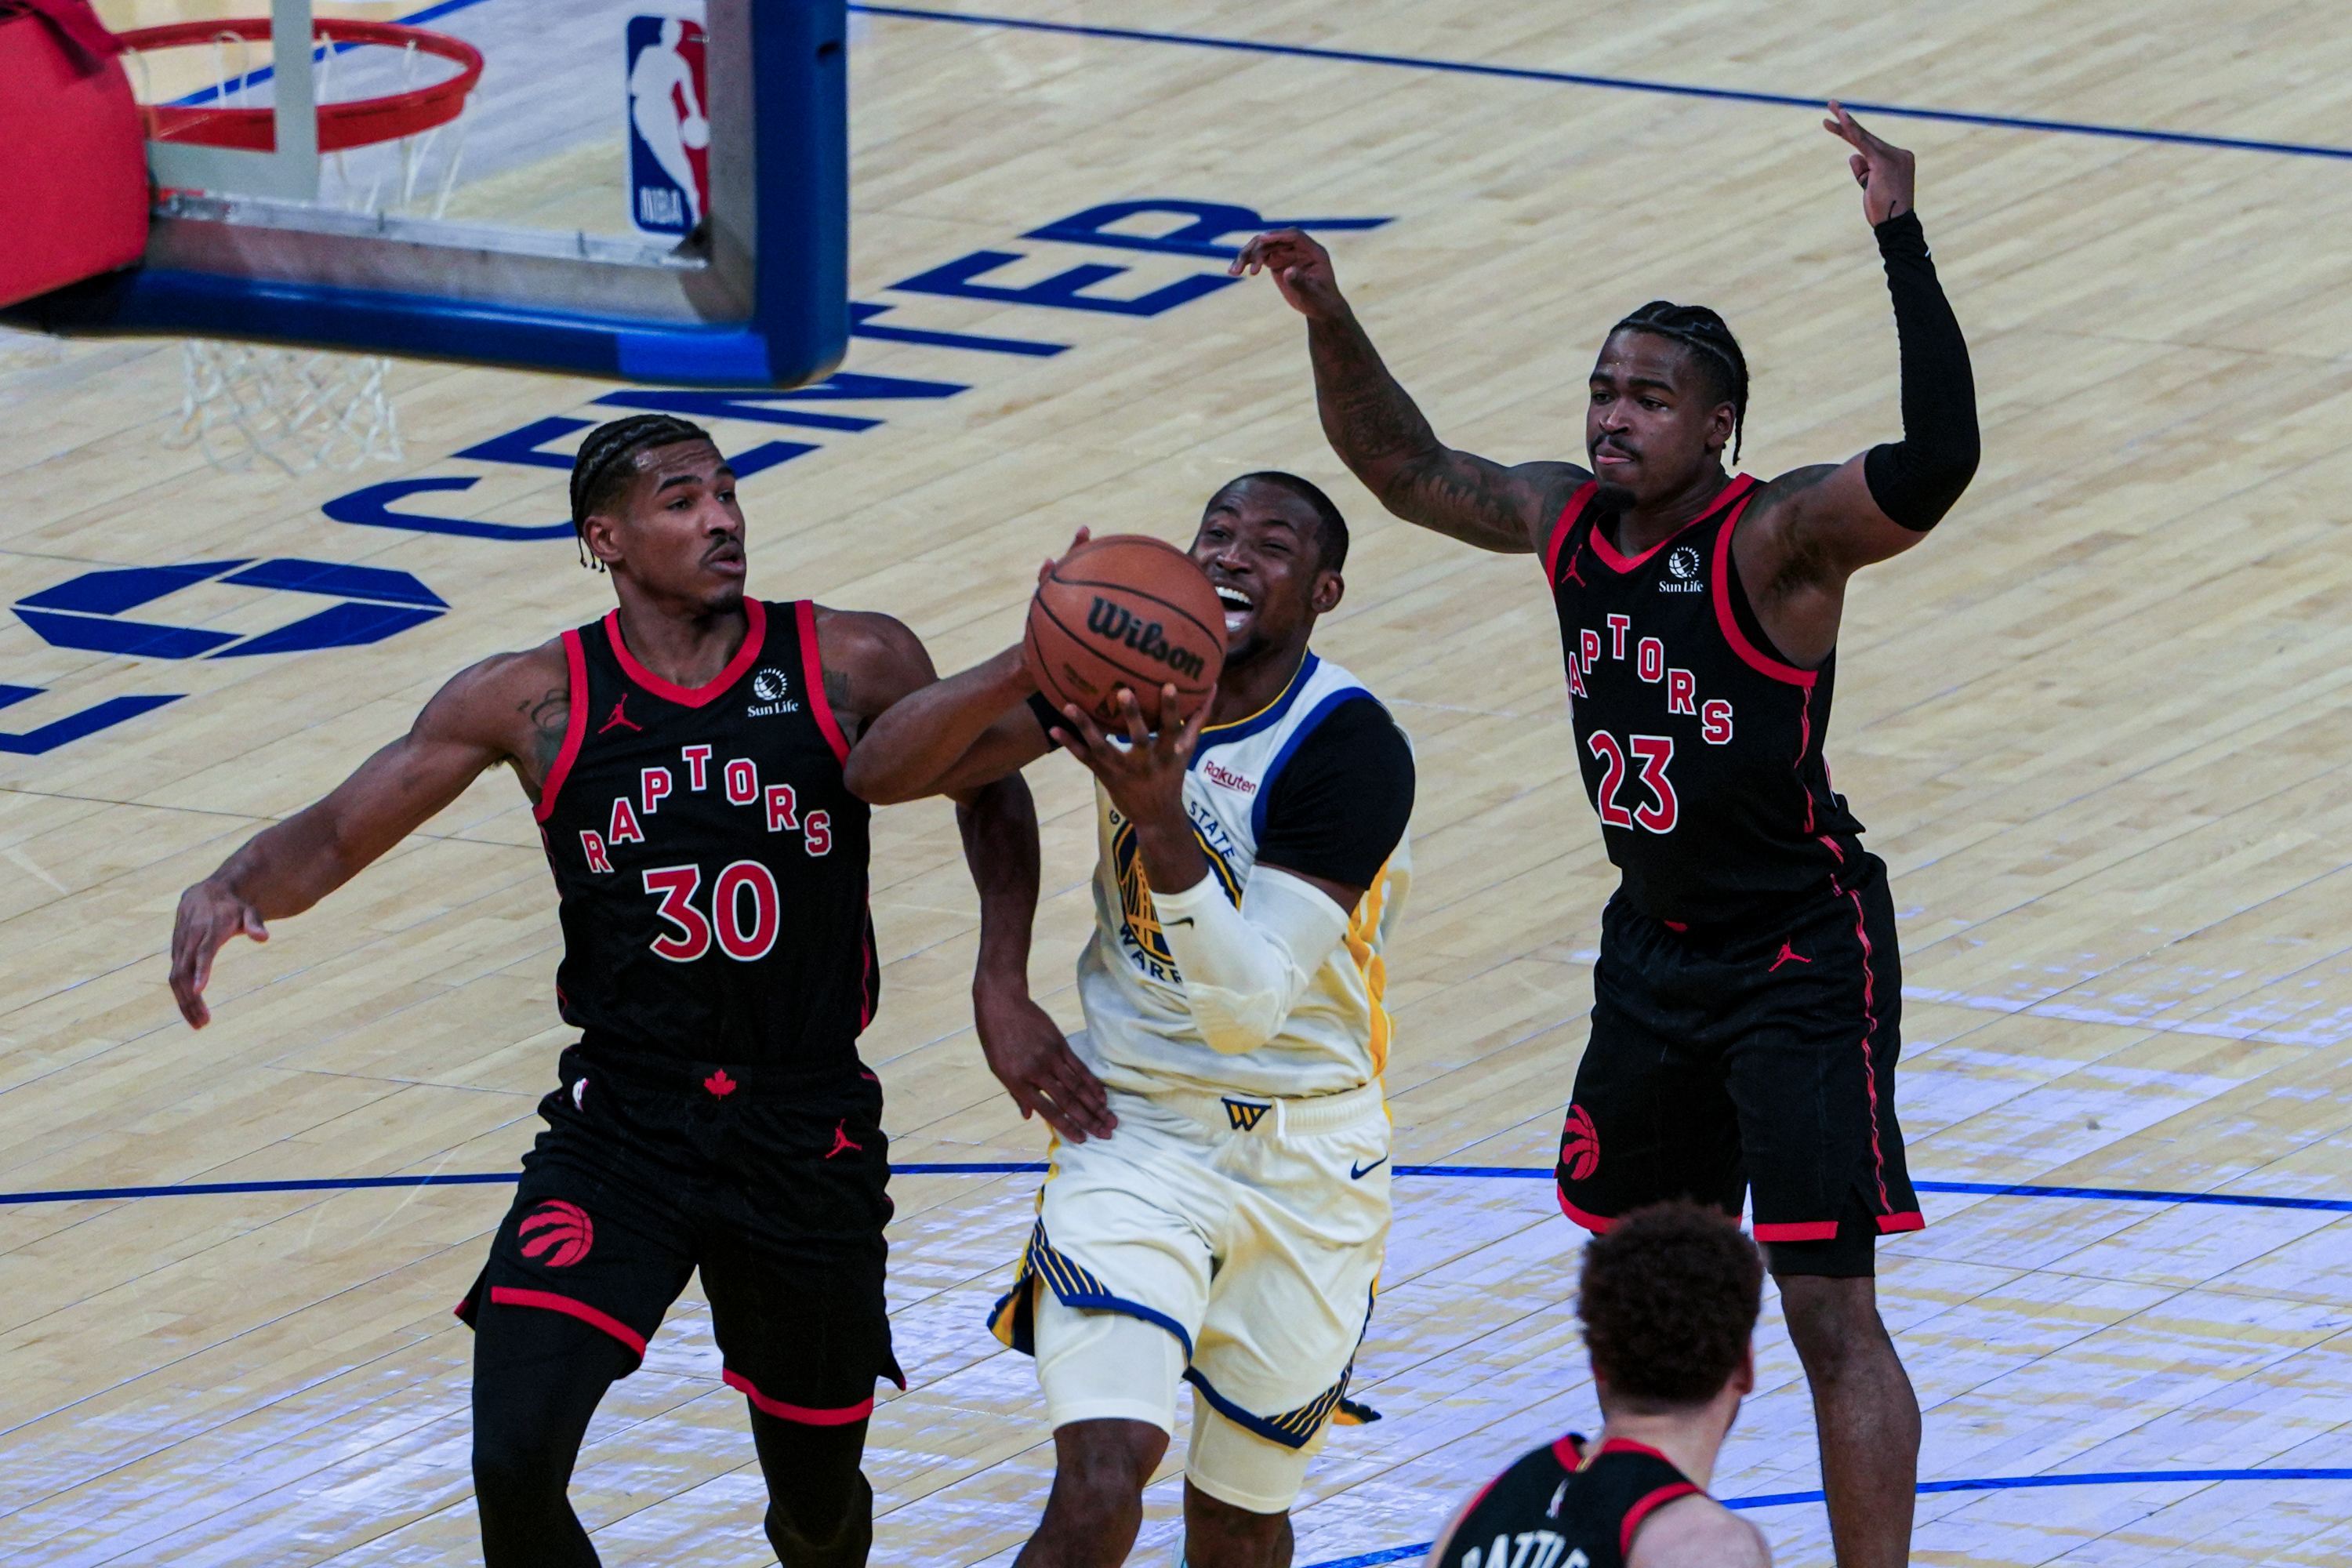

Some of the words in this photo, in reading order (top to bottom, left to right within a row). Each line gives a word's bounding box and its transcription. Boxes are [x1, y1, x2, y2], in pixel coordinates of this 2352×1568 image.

[639, 186, 684, 225] NBA
[1659, 581, 1682, 593] Sun
[1683, 580, 1704, 593] Life
[1087, 596, 1205, 681] Wilson
[747, 705, 773, 717] Sun
[775, 699, 799, 713] Life
[1567, 613, 1733, 745] APTORS
[579, 744, 832, 873] RAPTORS
[1203, 760, 1257, 795] Rakuten
[1587, 729, 1679, 834] 23
[1189, 800, 1235, 858] STATE
[642, 859, 780, 963] 30
